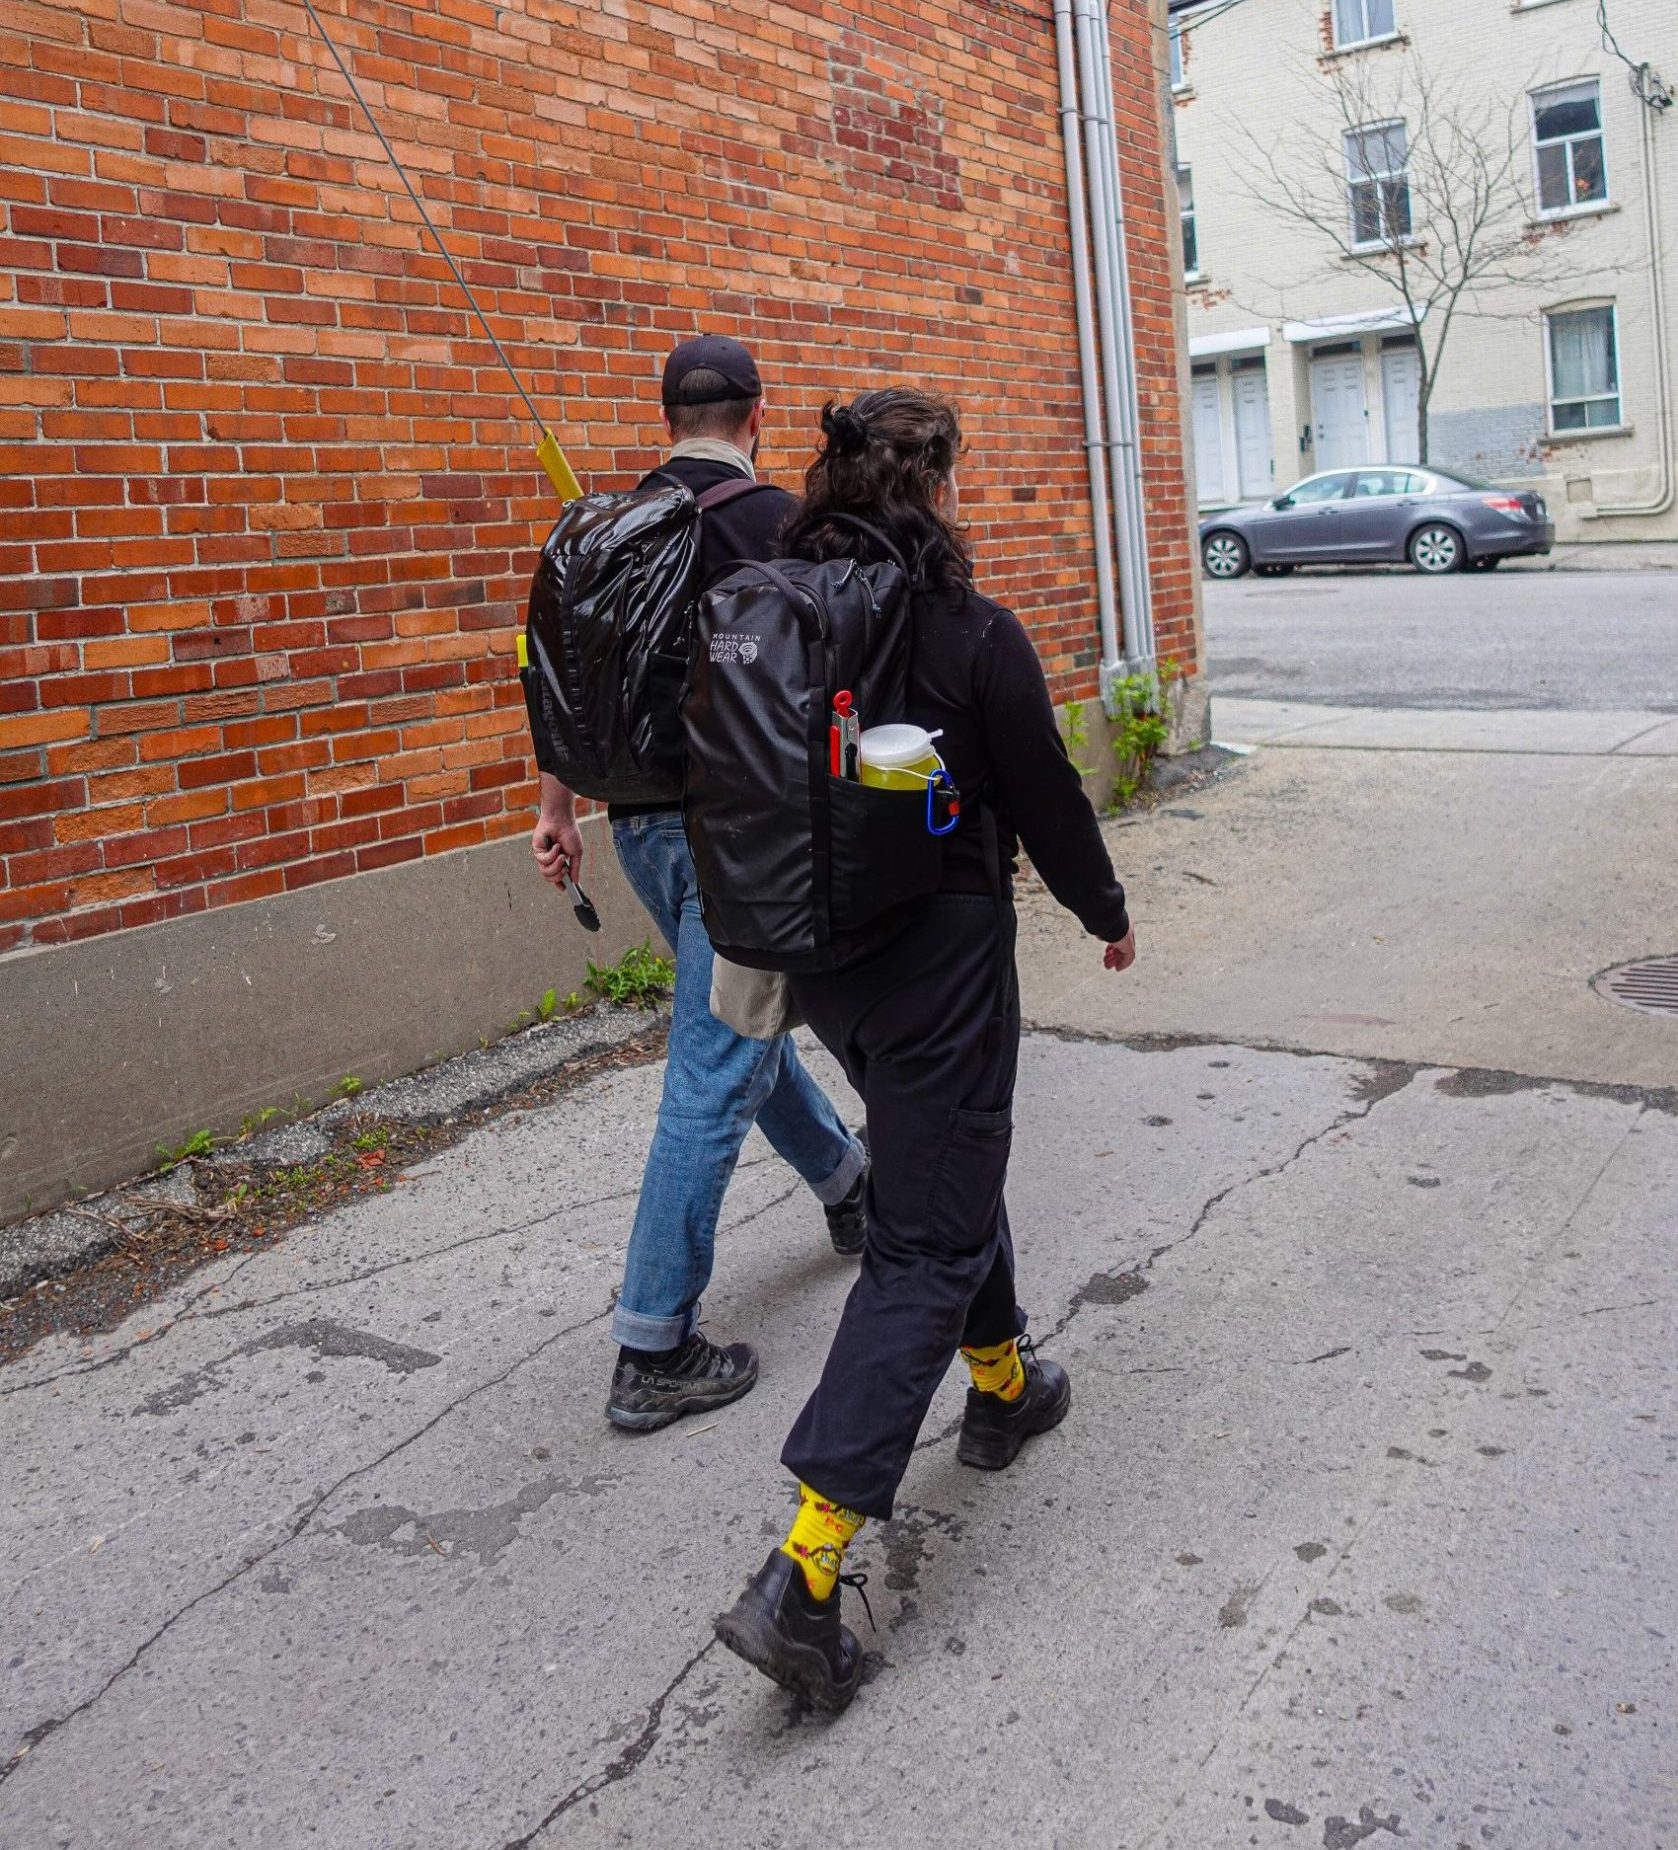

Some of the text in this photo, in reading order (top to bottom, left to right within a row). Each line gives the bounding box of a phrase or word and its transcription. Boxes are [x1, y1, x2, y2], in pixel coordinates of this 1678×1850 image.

[712, 633, 761, 641] MOUNTAIN
[710, 640, 739, 652] HARD
[709, 651, 738, 663] WEAR
